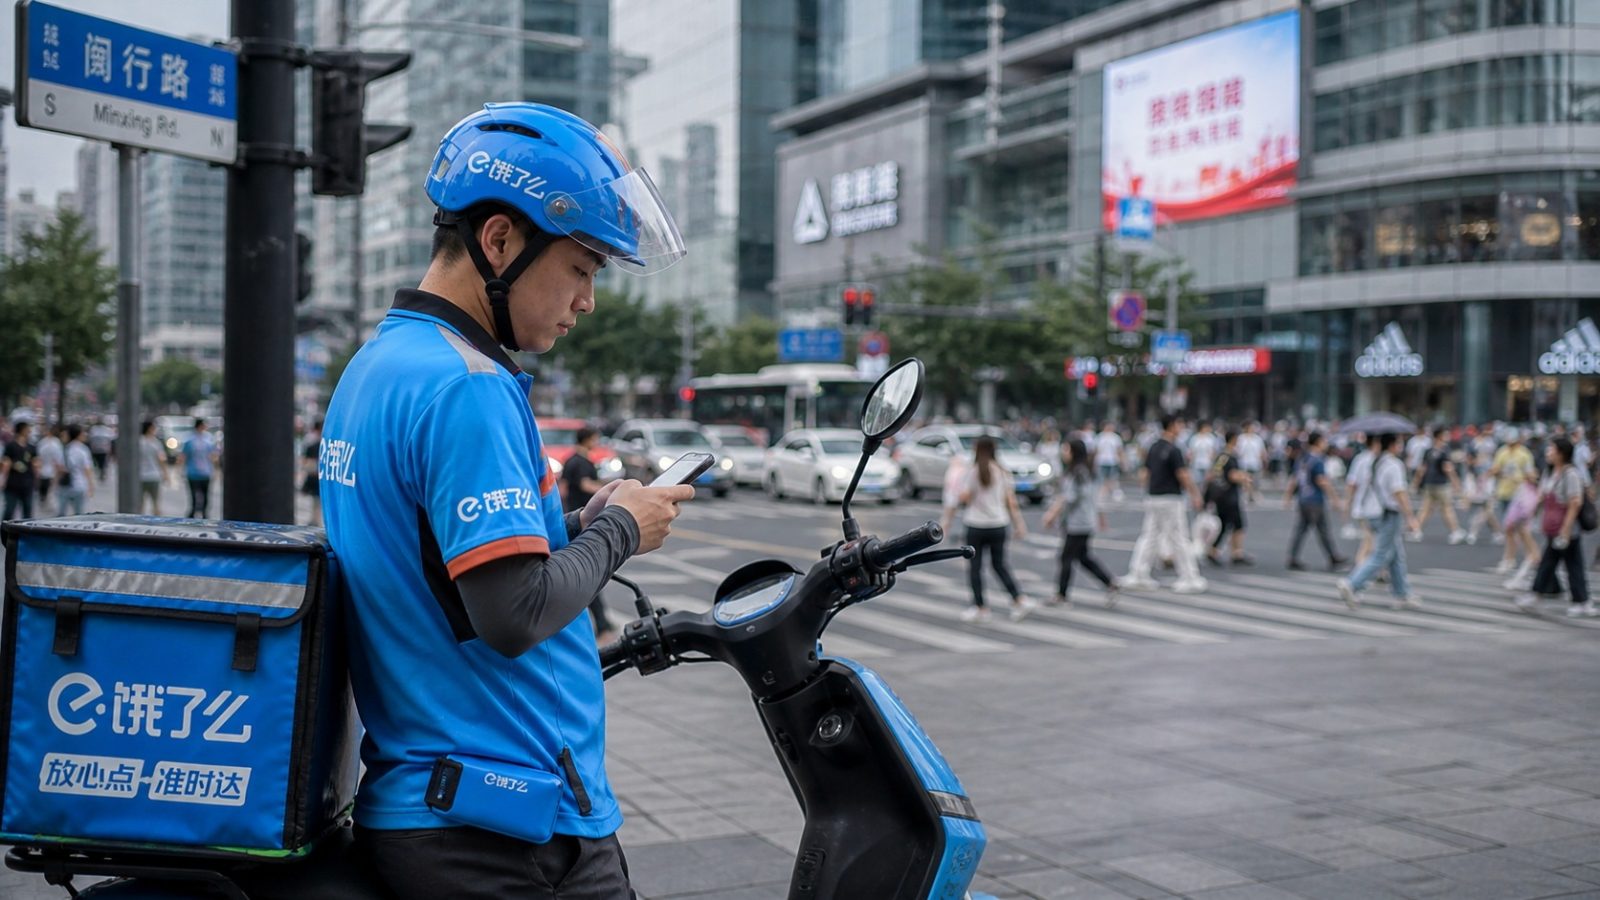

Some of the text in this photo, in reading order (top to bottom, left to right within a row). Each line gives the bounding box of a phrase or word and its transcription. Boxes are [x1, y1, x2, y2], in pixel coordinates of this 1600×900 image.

[44, 92, 57, 116] S
[156, 114, 181, 139] Rd.
[210, 127, 224, 149] N
[154, 766, 243, 800] 准时达
